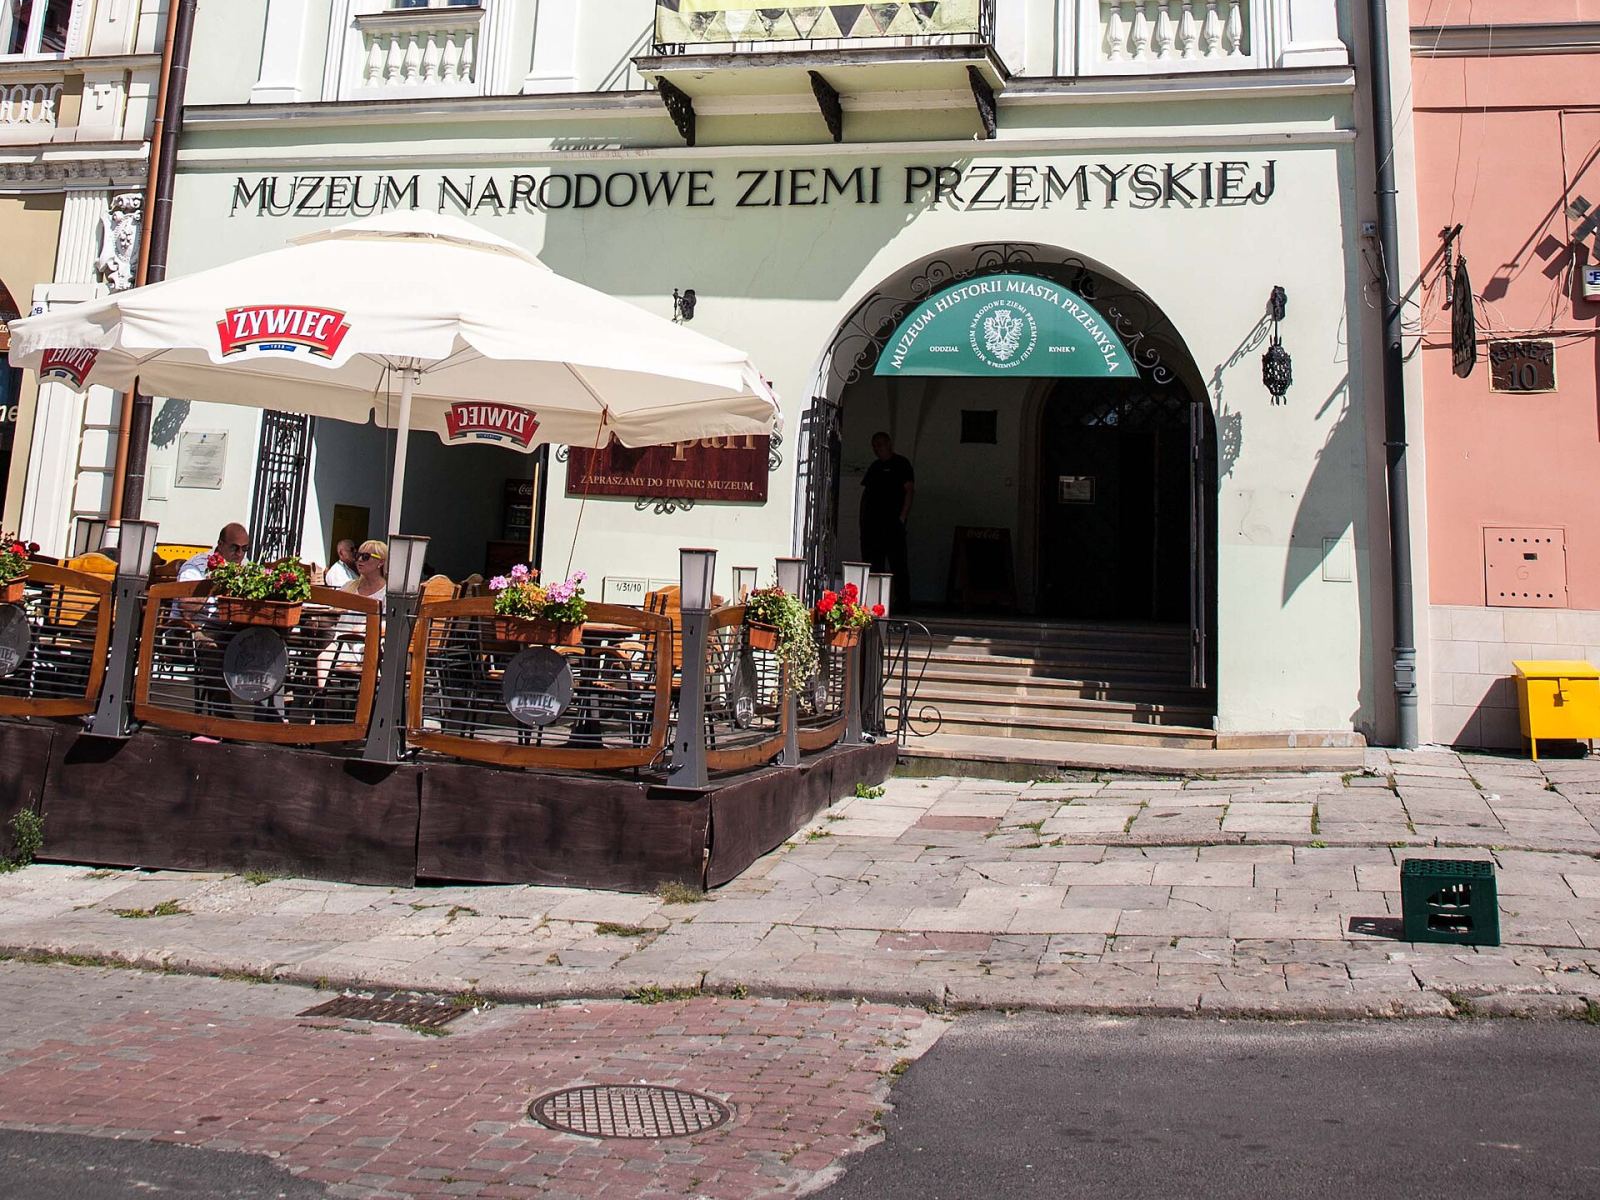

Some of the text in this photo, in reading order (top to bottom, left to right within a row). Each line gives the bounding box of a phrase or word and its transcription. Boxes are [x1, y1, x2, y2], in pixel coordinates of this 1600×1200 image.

[233, 158, 1278, 211] MUZEUM NARODOWE ZIEMI PRZEMYSKIEJ
[233, 307, 336, 341] ŻYWIEC
[890, 280, 1120, 374] MUZEUM HISTORII MIASTA PRZEMYŚLA
[969, 299, 1038, 362] MUZEUM NARODOWE ZIEMI PRZEMYSKIEJ
[929, 345, 960, 353] ODDZIAŁ
[1071, 345, 1076, 353] 9
[1508, 362, 1538, 389] 10
[581, 474, 754, 491] ZAPRASZAMY DO PIWNIC MUZEUM
